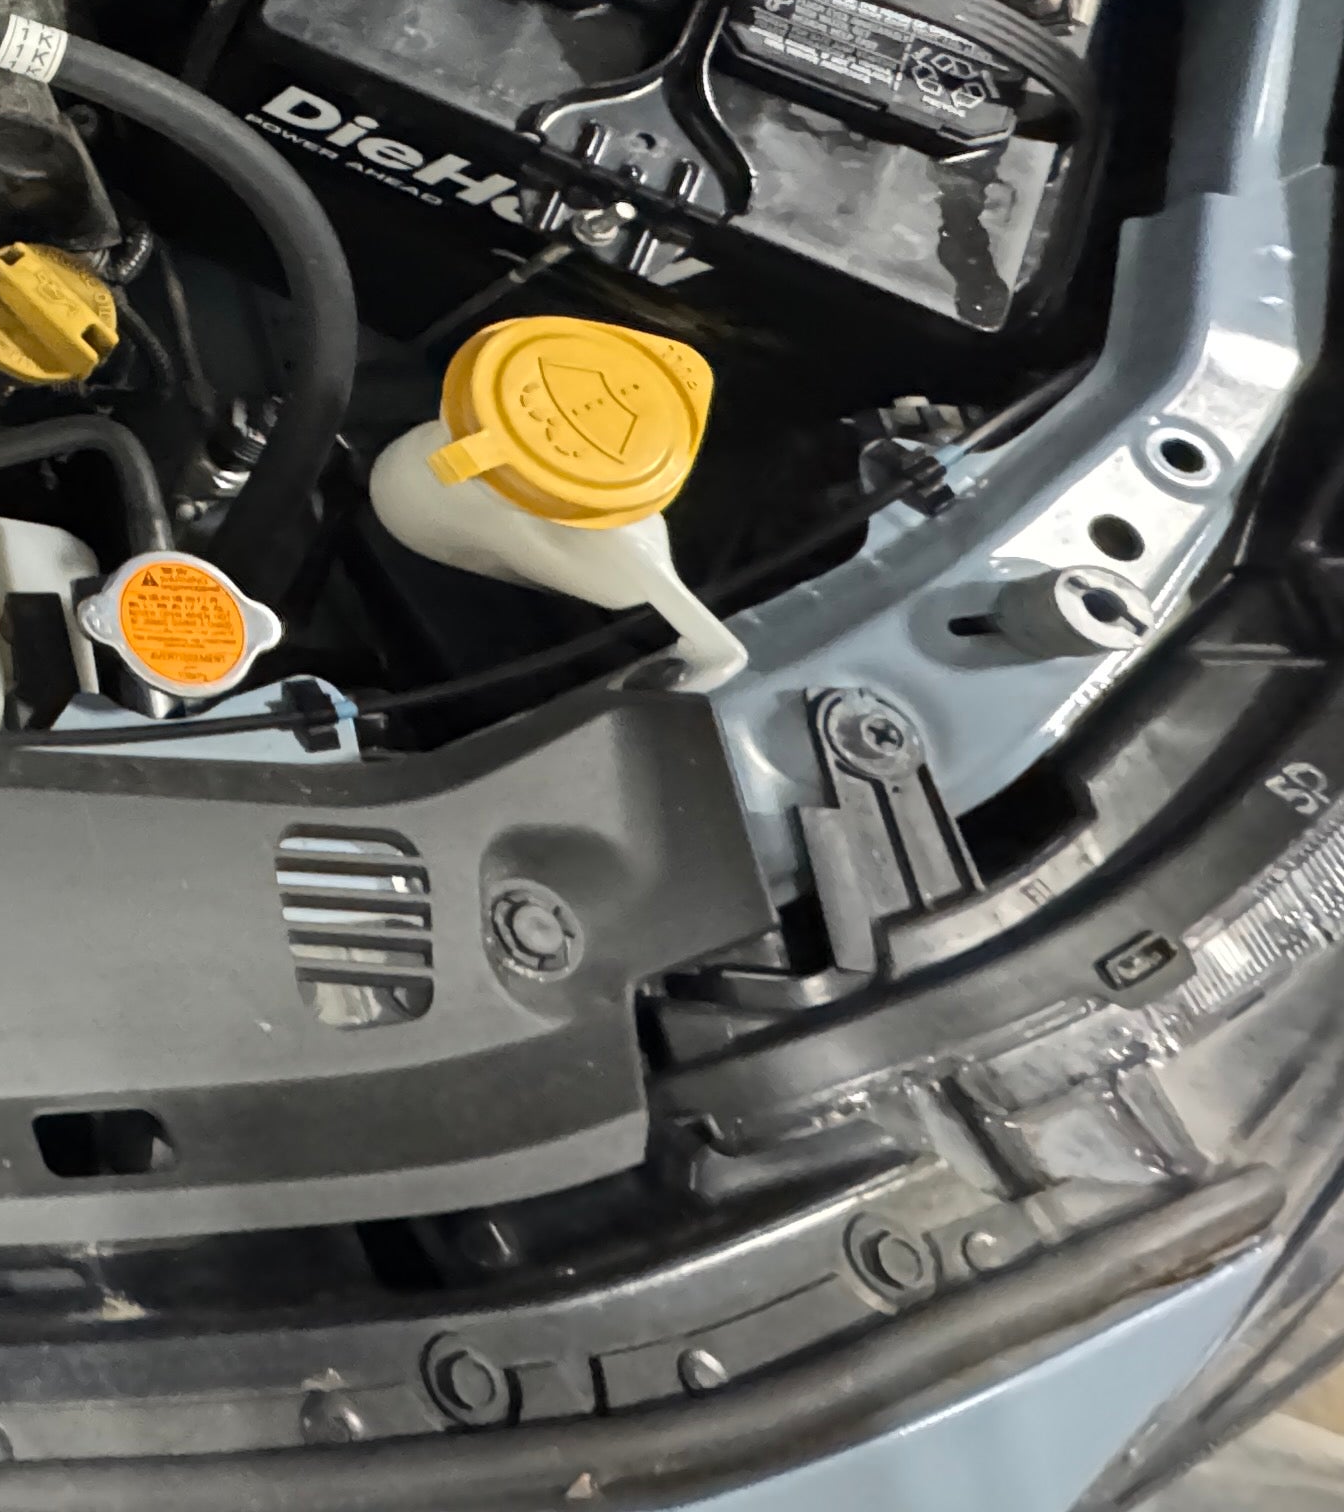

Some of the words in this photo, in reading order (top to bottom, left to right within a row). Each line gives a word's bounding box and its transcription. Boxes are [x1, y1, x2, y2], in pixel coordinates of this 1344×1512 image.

[245, 113, 339, 160] POWER
[346, 161, 444, 206] AHEAD
[261, 85, 714, 286] DieH
